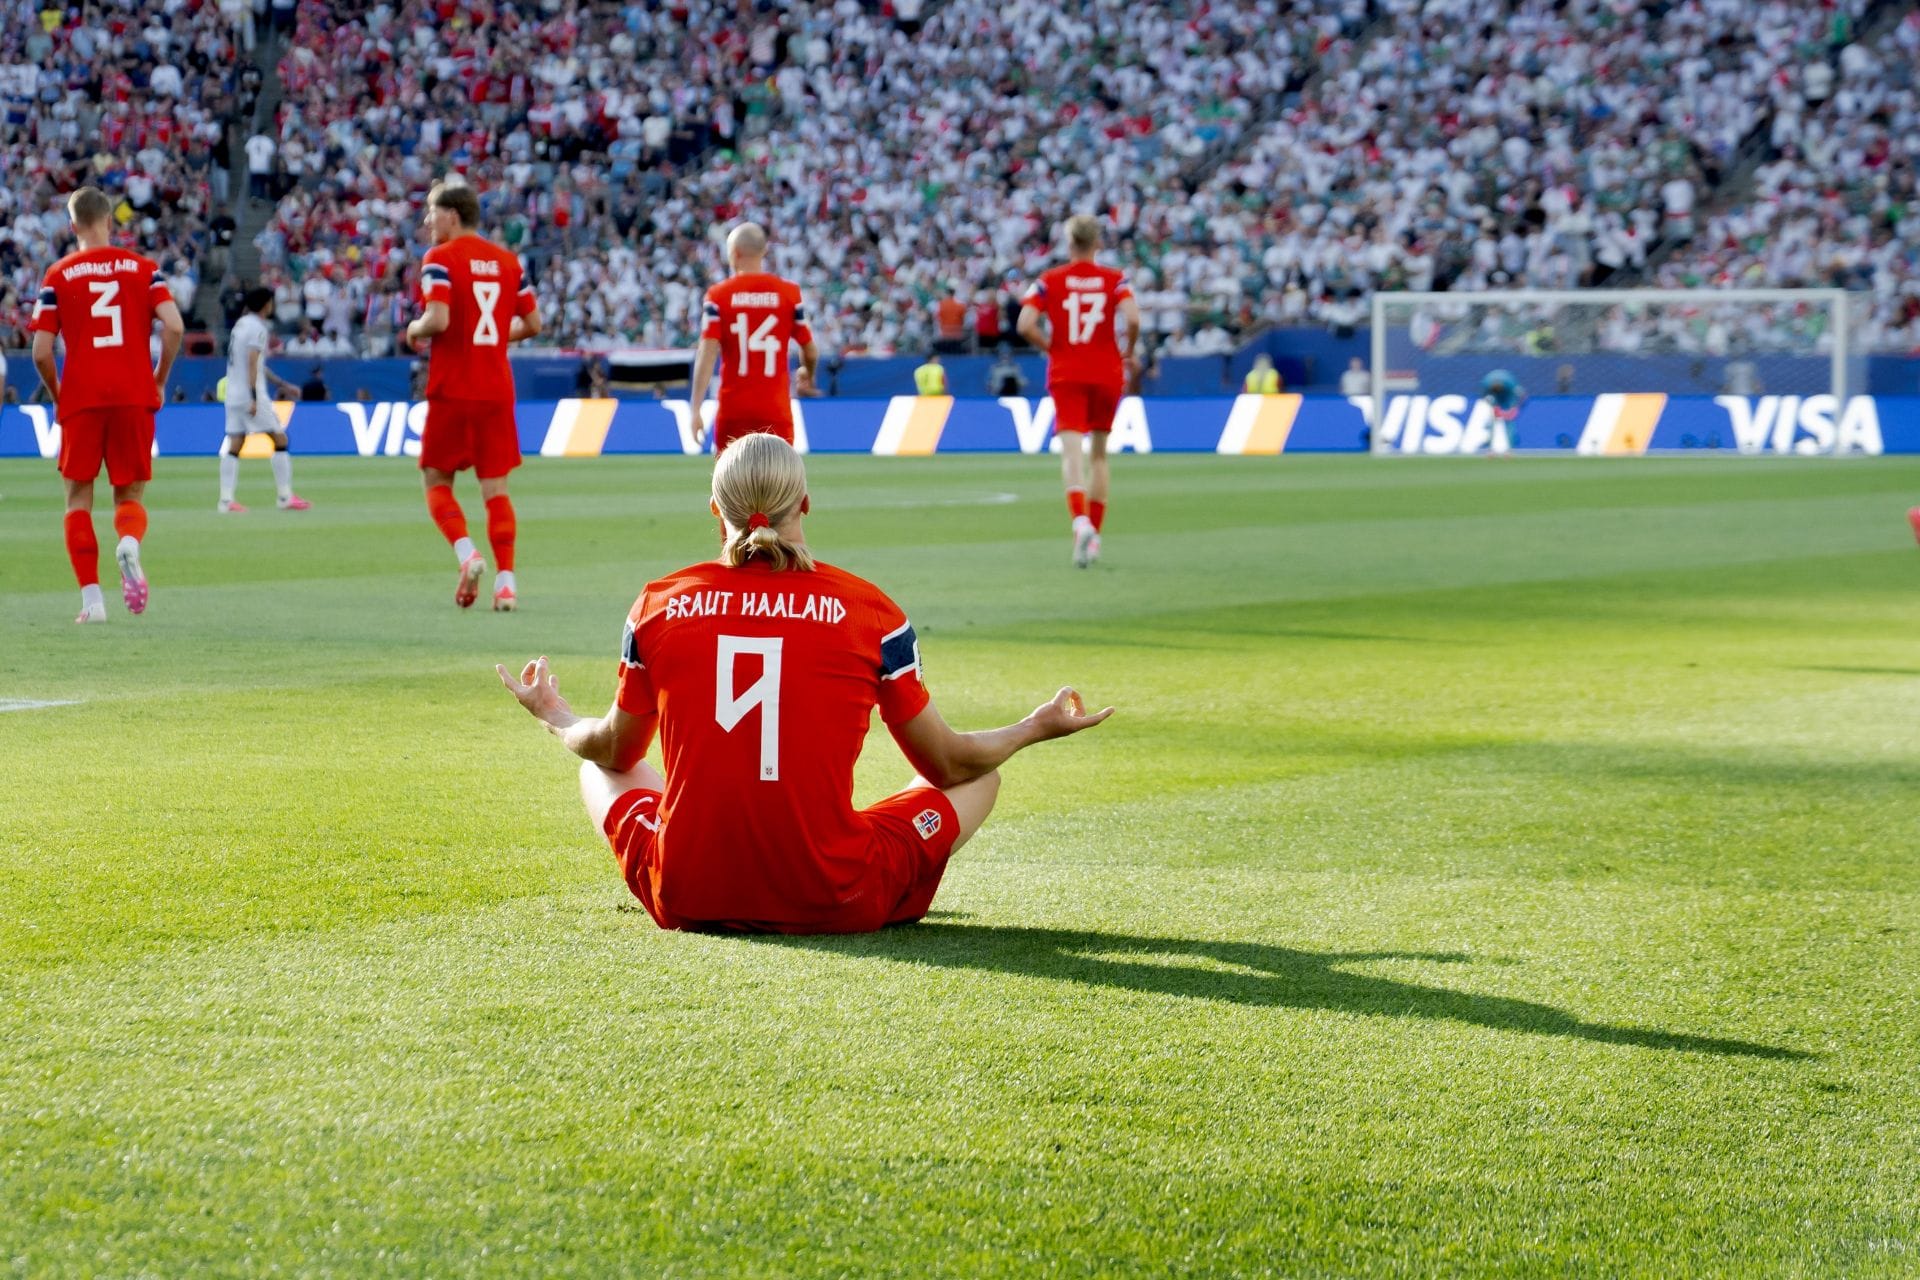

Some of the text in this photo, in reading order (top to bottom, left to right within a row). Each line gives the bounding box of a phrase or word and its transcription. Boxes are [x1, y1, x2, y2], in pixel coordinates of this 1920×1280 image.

[89, 281, 123, 347] 3
[473, 281, 500, 345] 8
[1062, 292, 1107, 345] 17
[730, 312, 781, 377] 14
[997, 396, 1153, 453] VA
[1713, 395, 1884, 454] VISA
[666, 591, 847, 624] BRAUT HAALAND
[715, 635, 783, 781] 9
